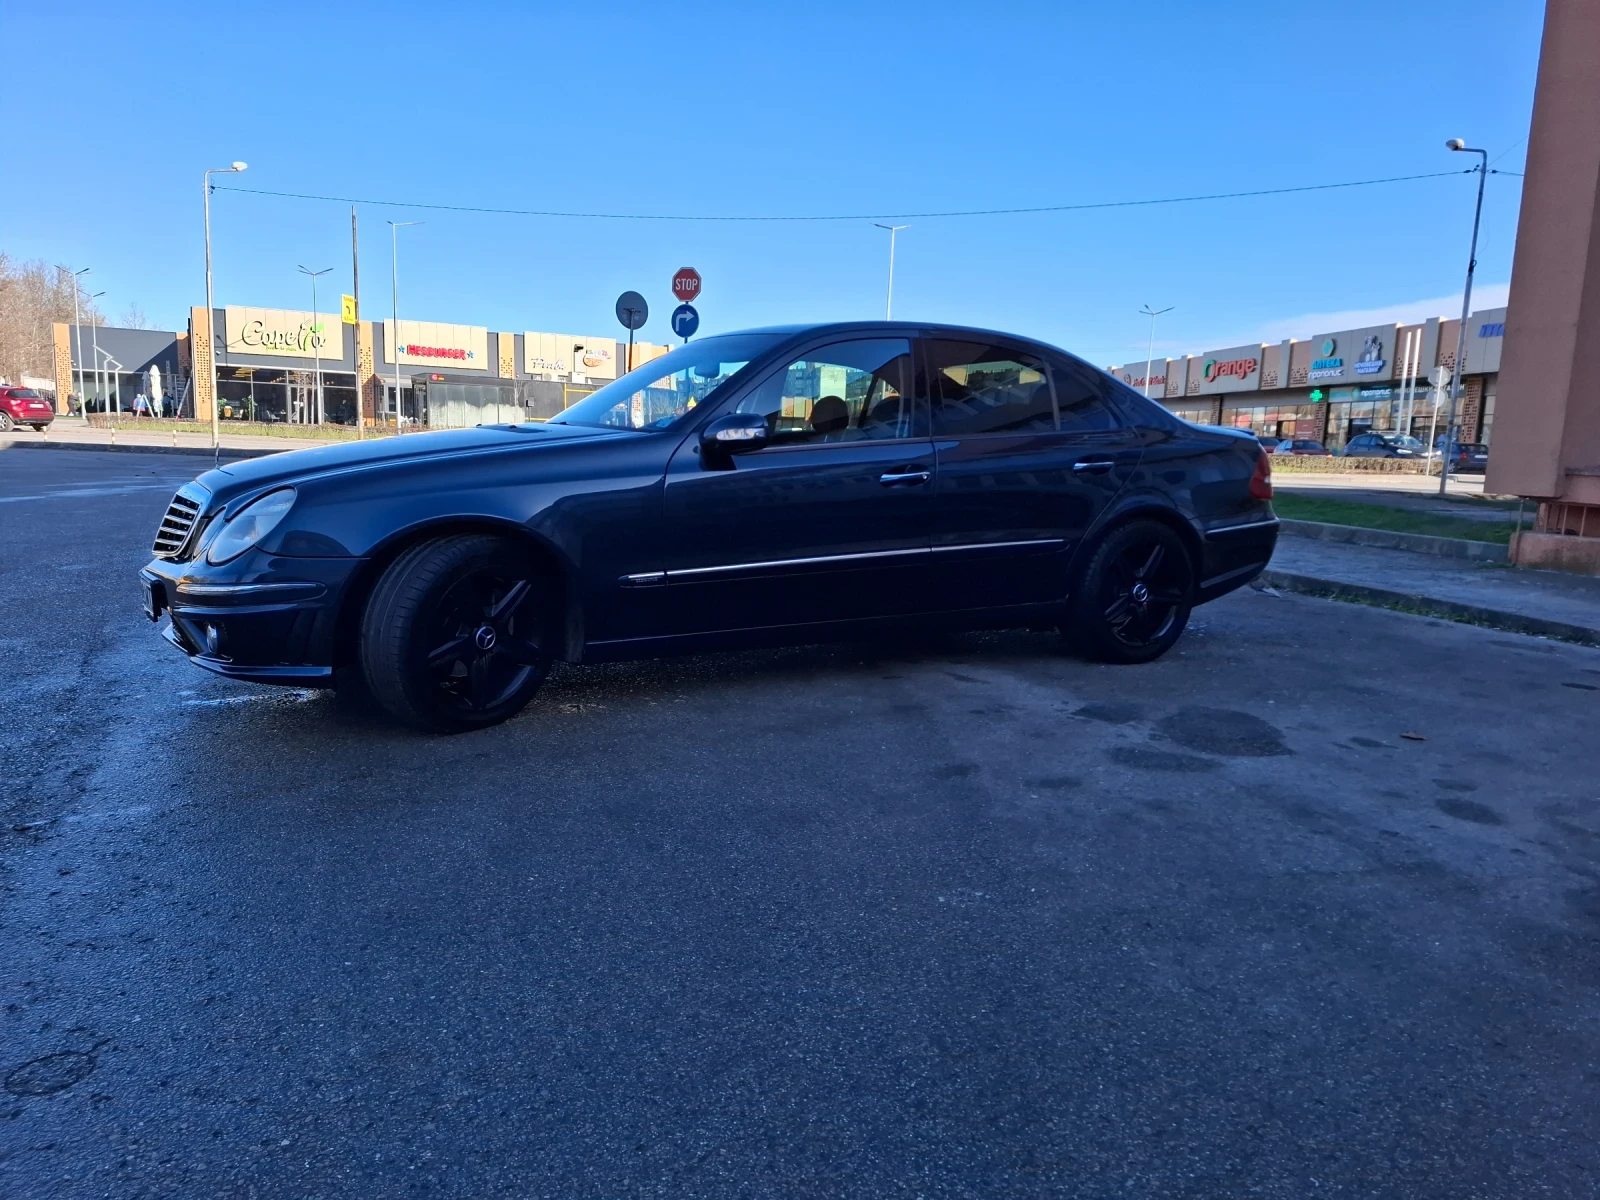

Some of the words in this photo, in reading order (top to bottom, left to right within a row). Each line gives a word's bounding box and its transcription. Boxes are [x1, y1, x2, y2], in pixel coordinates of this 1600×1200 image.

[675, 278, 698, 291] STOP
[407, 344, 466, 360] HESBURGER
[1203, 358, 1256, 383] Orange
[1312, 358, 1342, 369] АПТЕКА
